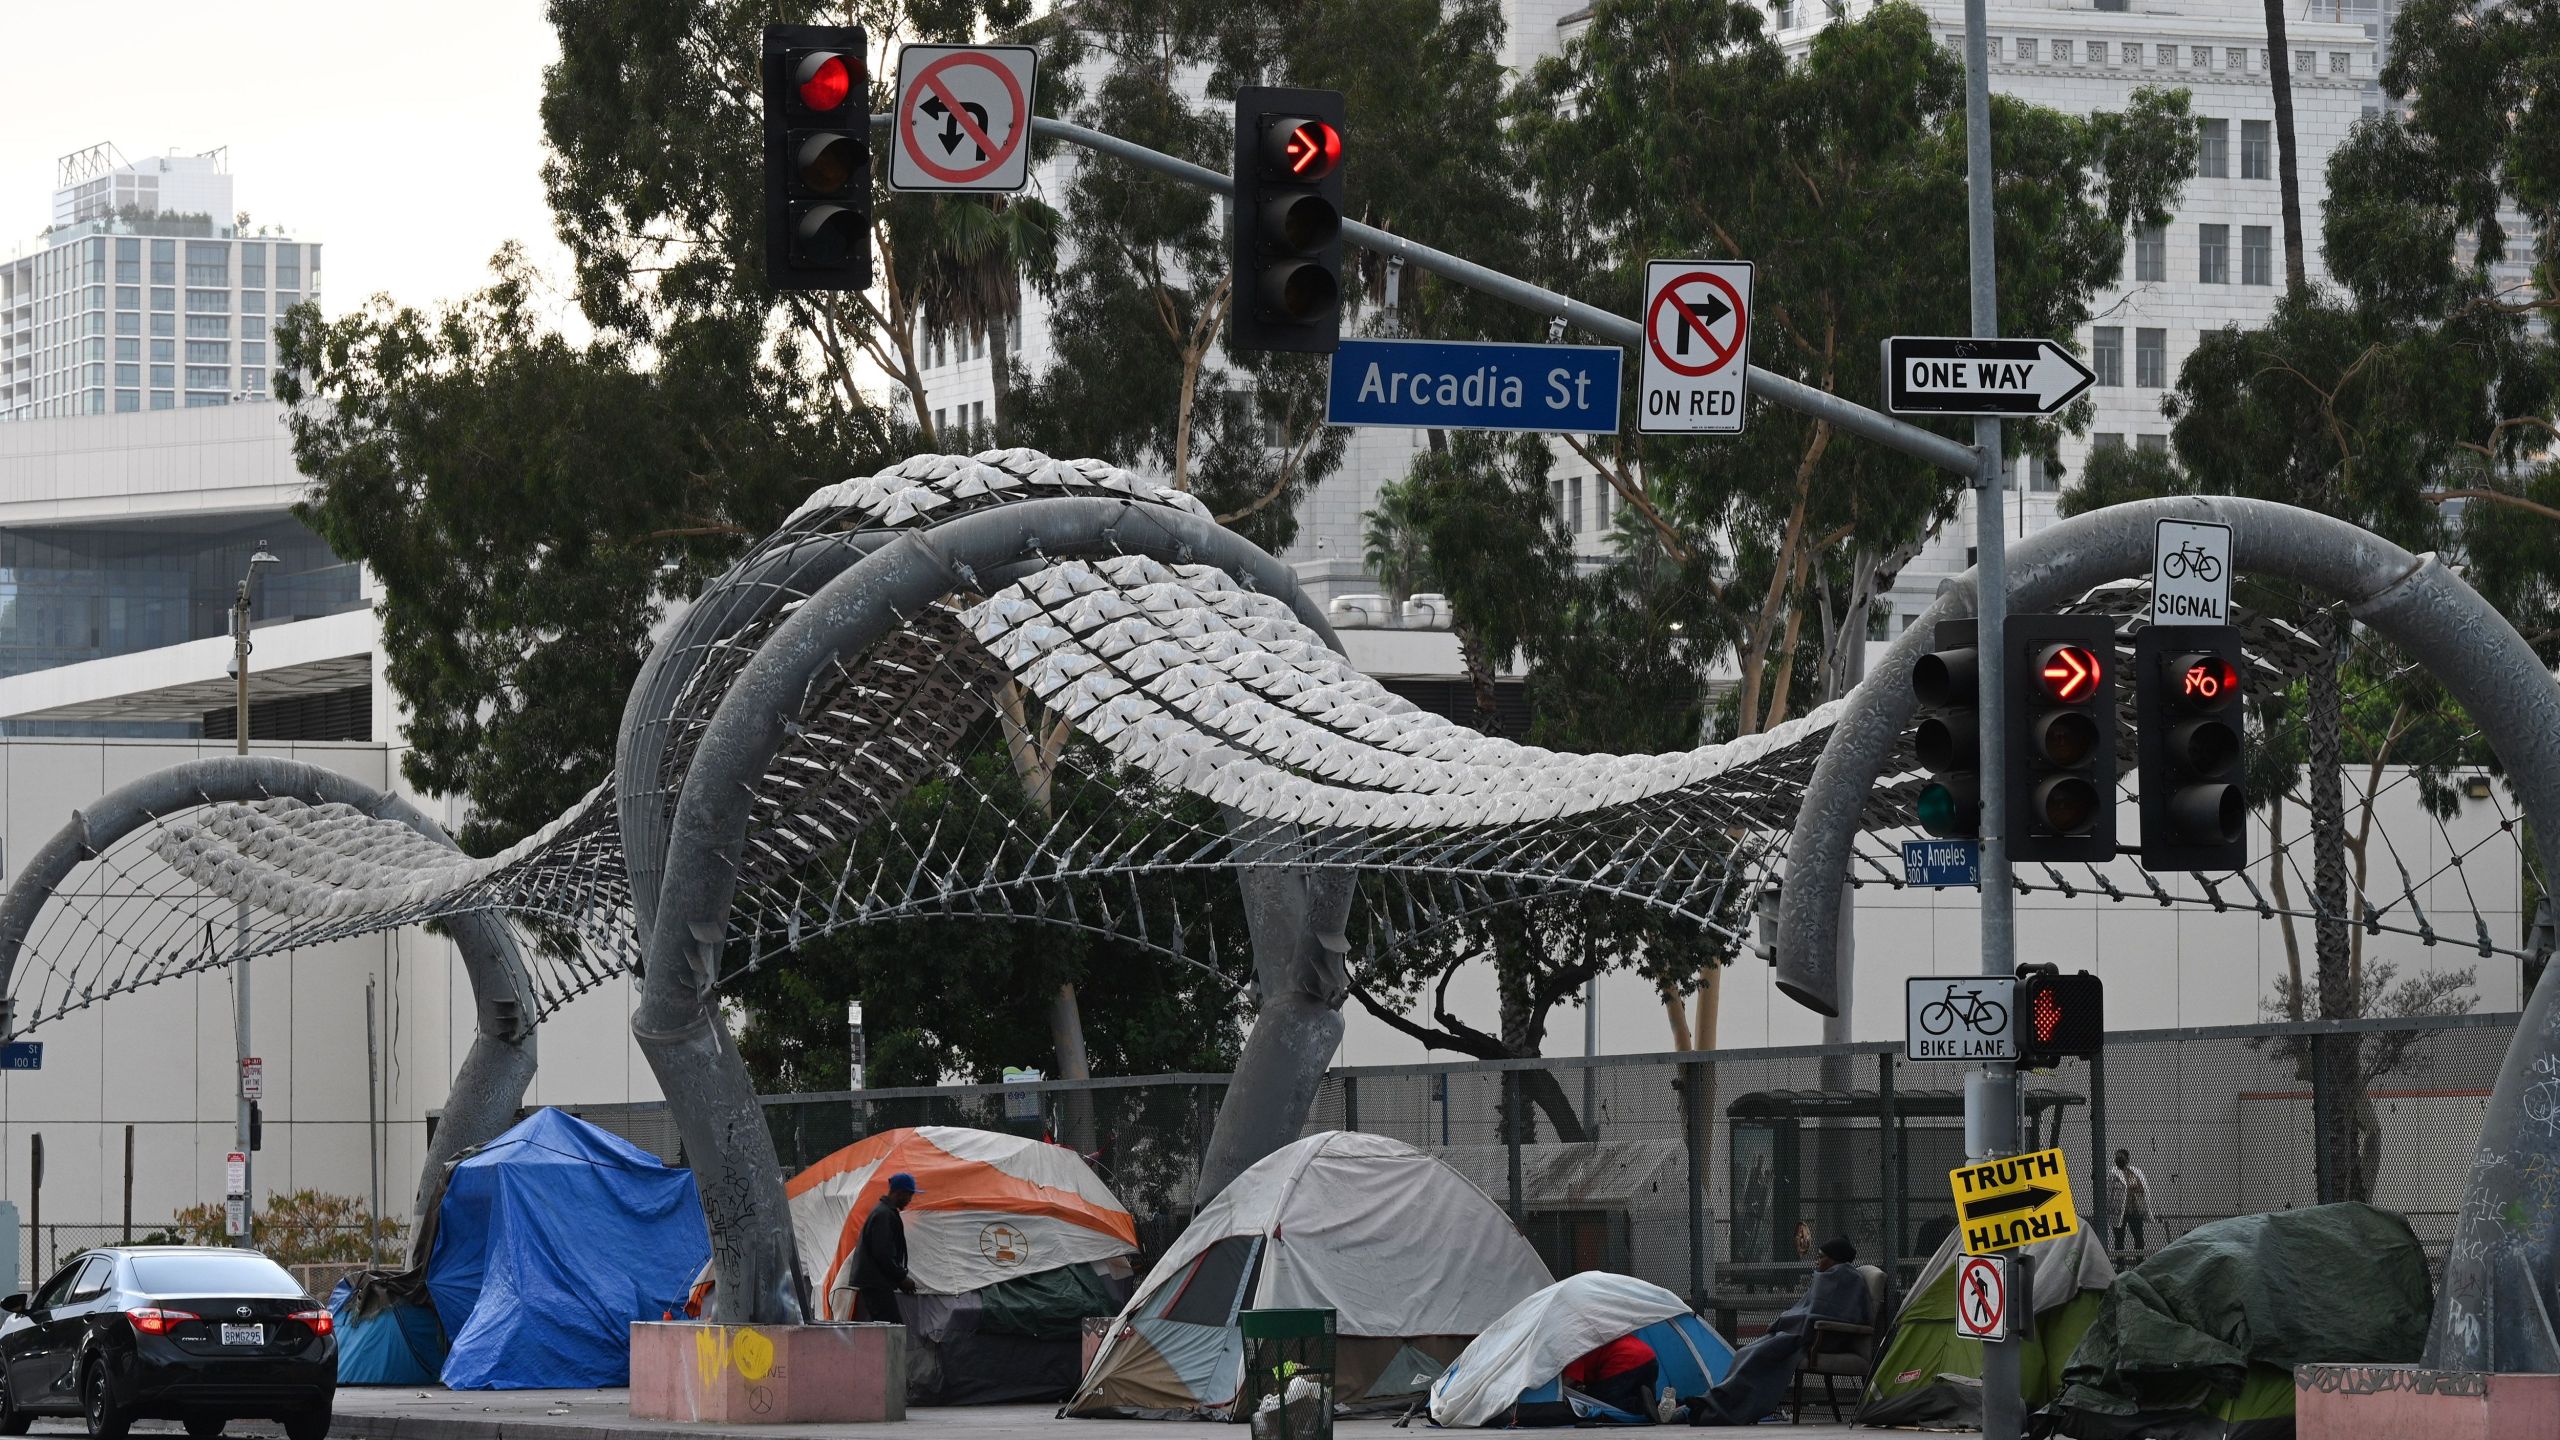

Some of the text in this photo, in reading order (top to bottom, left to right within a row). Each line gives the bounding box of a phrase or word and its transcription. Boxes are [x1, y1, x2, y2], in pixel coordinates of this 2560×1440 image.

[1357, 362, 1592, 410] Arcadia St
[1912, 361, 2034, 390] ONE WAY
[1649, 390, 1736, 416] ON RED
[2157, 593, 2222, 619] SIGNAL
[1905, 843, 1966, 874] Los Angeles
[1907, 866, 1977, 883] 300 N St
[28, 1044, 38, 1054] St
[1920, 1040, 2005, 1056] BIKE LANE
[14, 1057, 38, 1068] 100 E
[1957, 1152, 2059, 1193] TRUTH
[1968, 1211, 2071, 1251] TRUTH
[225, 1331, 261, 1341] 8RMG295
